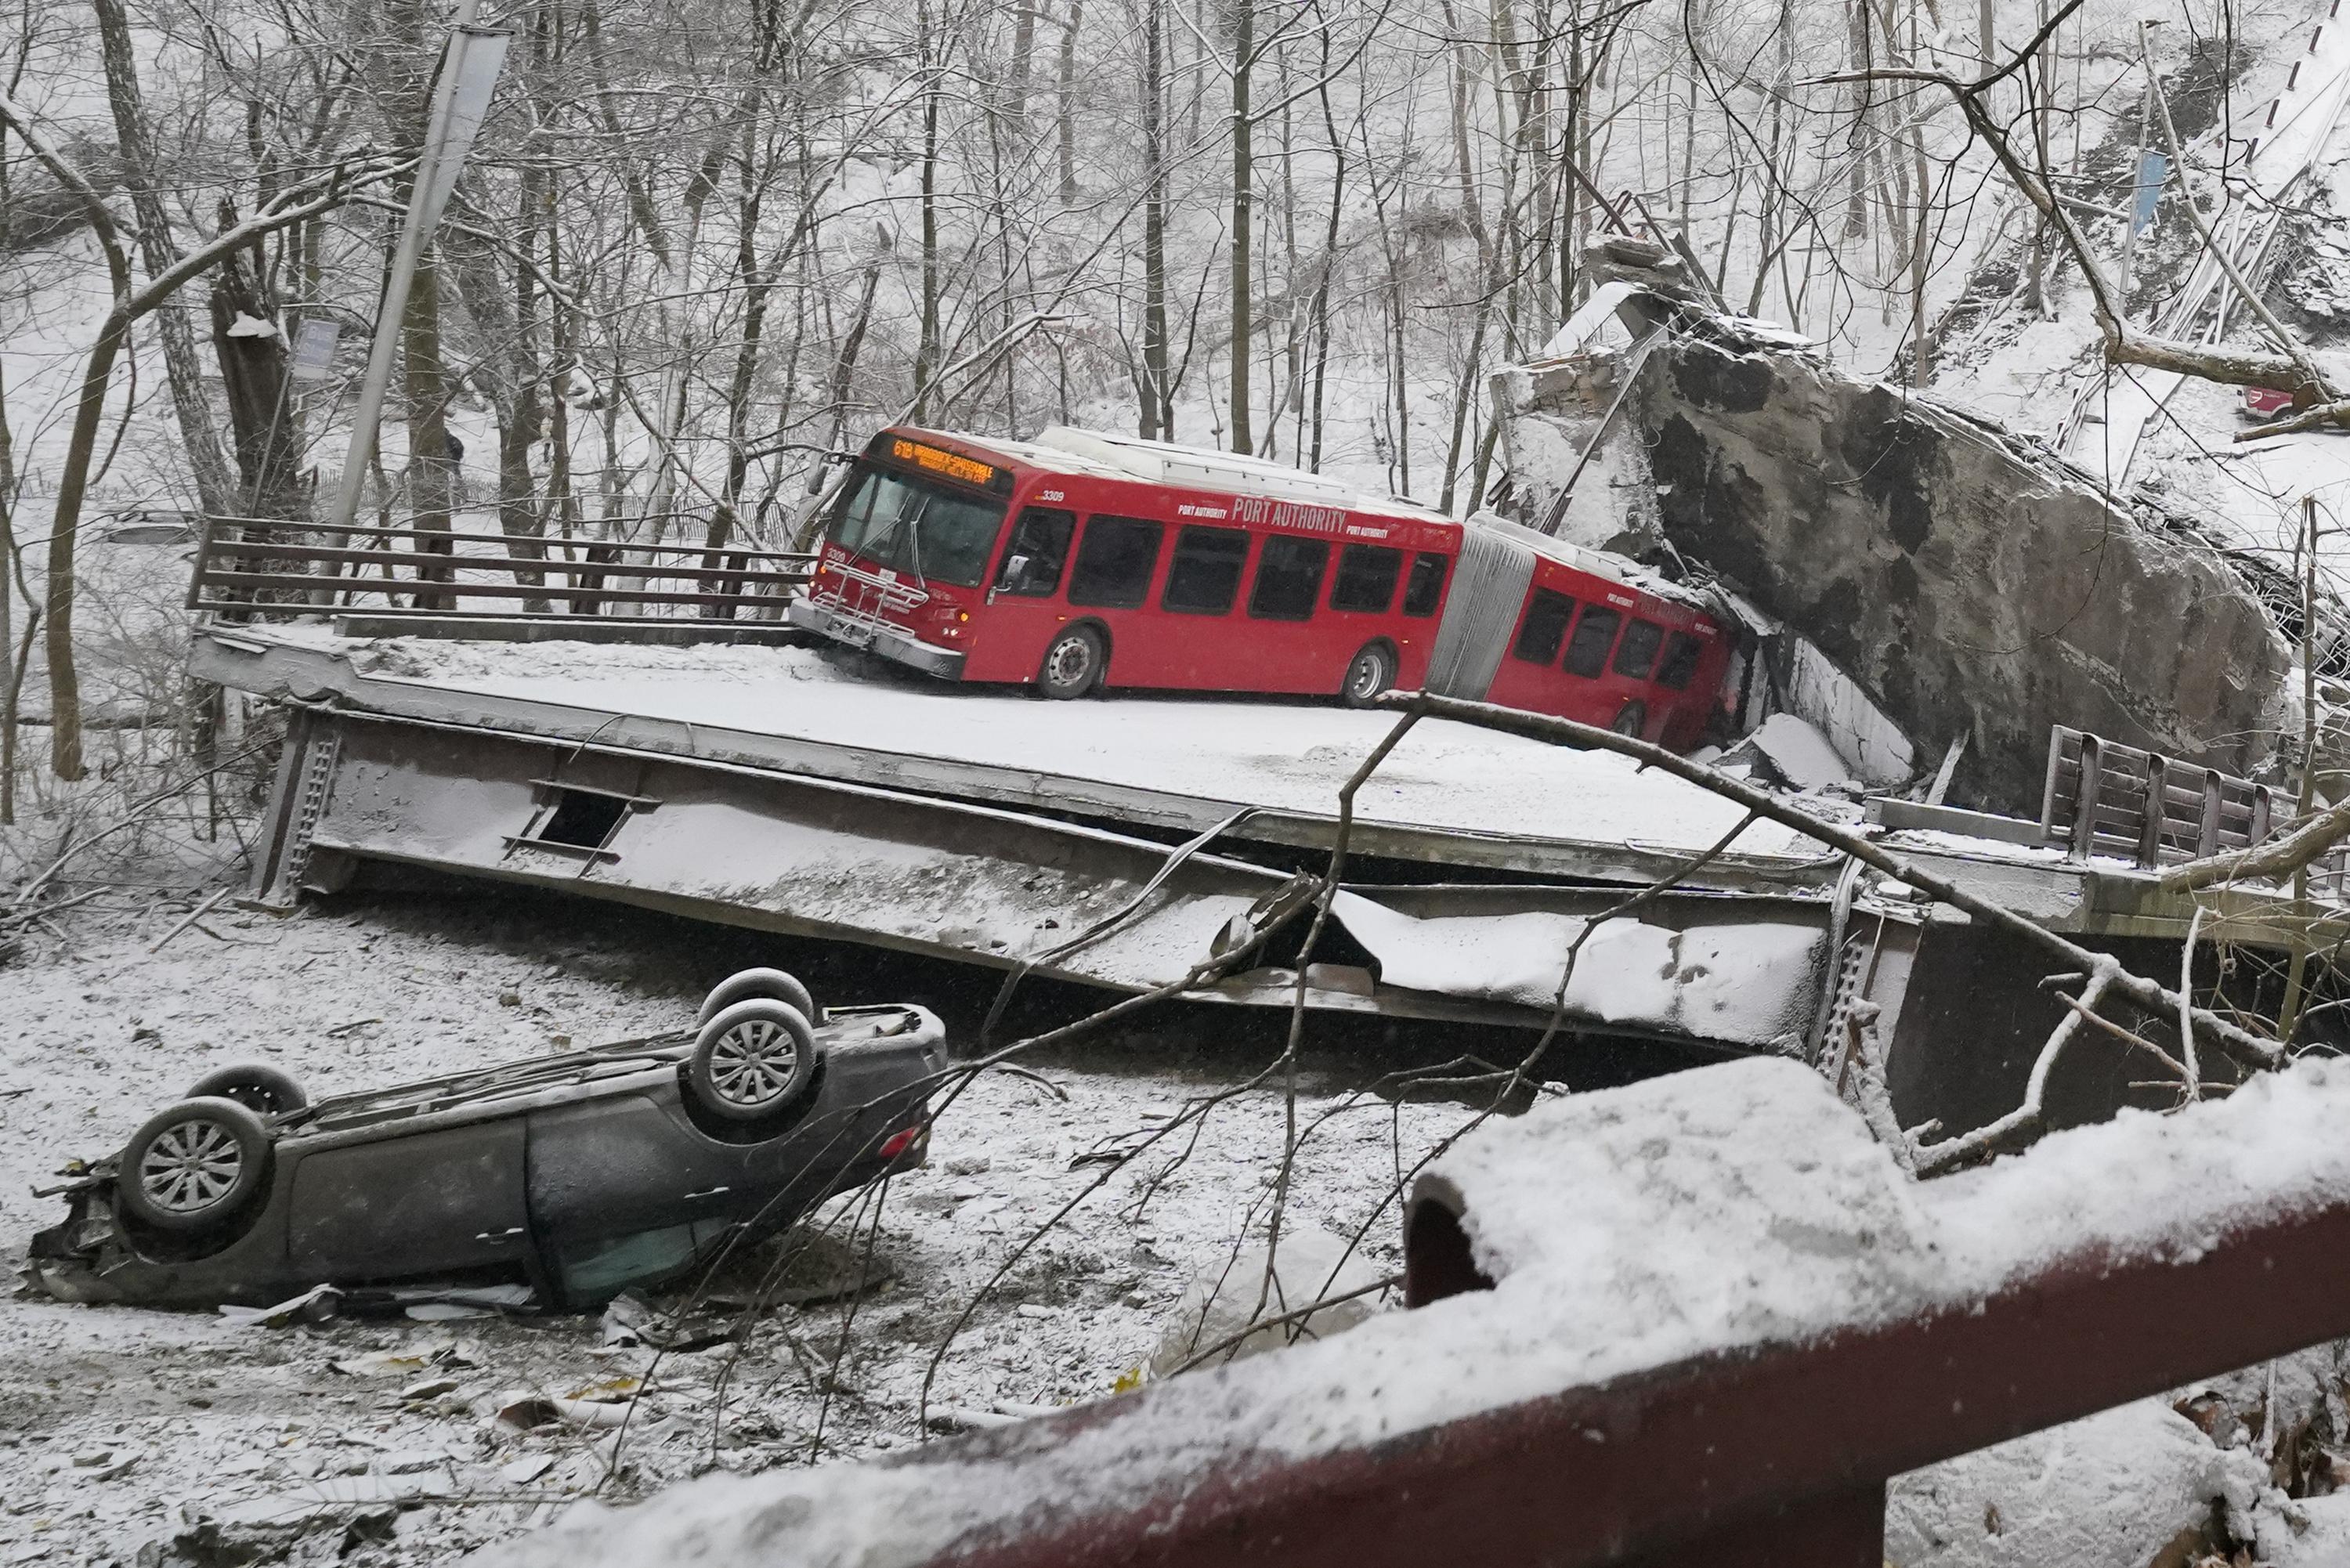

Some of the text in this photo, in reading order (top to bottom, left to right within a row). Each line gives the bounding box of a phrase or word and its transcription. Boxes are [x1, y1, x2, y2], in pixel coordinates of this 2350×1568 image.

[307, 326, 333, 341] Bus
[893, 439, 913, 459] 61B
[1043, 490, 1065, 502] 3309
[1178, 504, 1227, 519] PORT AUTHORITY
[1231, 498, 1347, 533] PORT AUTHORITY
[1346, 525, 1361, 535] PORT
[827, 547, 846, 562] 3309
